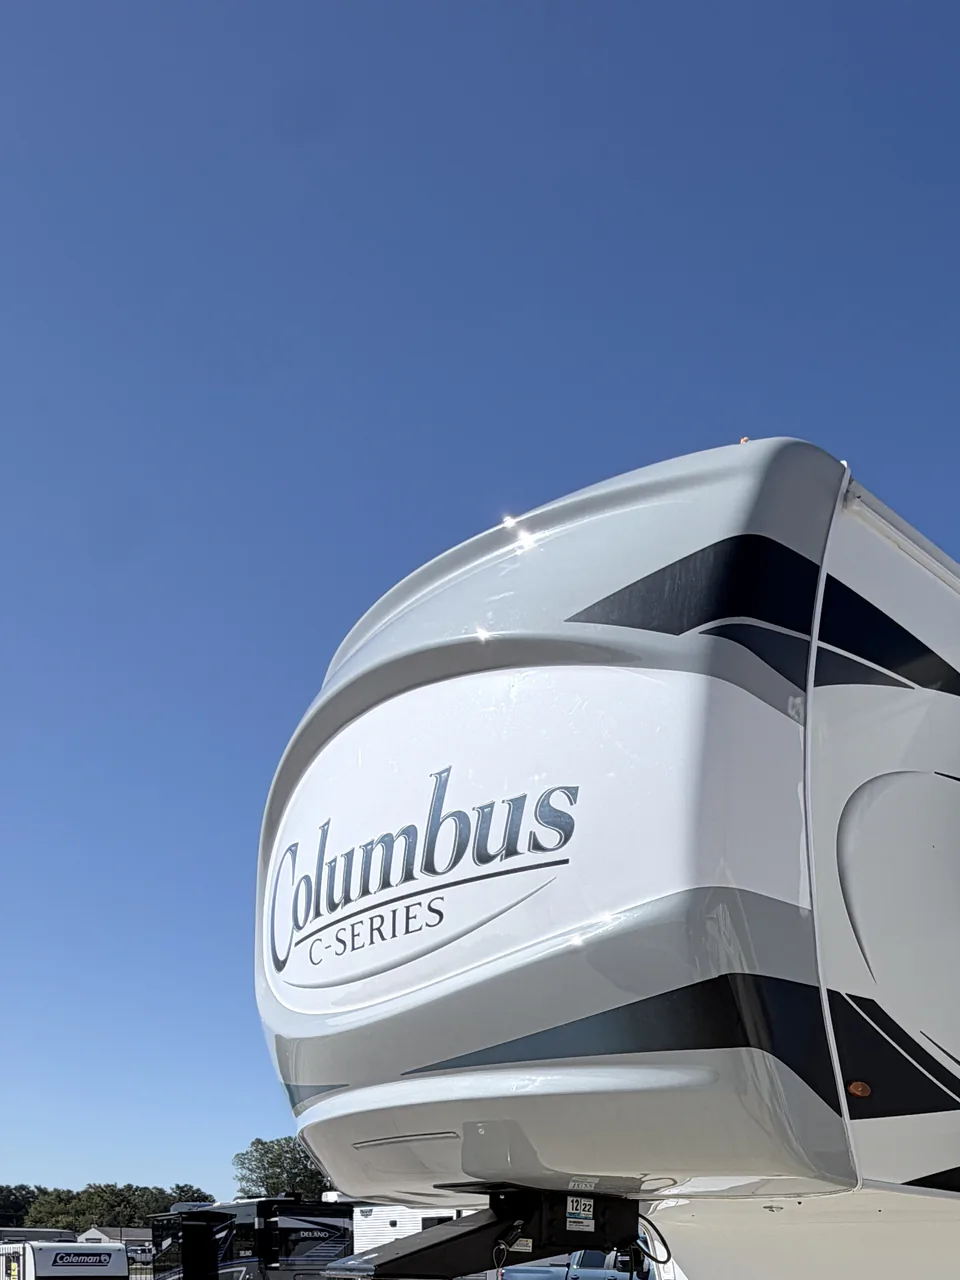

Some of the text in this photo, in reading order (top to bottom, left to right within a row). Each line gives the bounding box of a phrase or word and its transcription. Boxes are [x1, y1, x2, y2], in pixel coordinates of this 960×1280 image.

[270, 765, 579, 973] Columbus
[309, 896, 445, 967] C-SERIES
[570, 1199, 592, 1212] 12 22
[56, 1253, 99, 1263] Coleman
